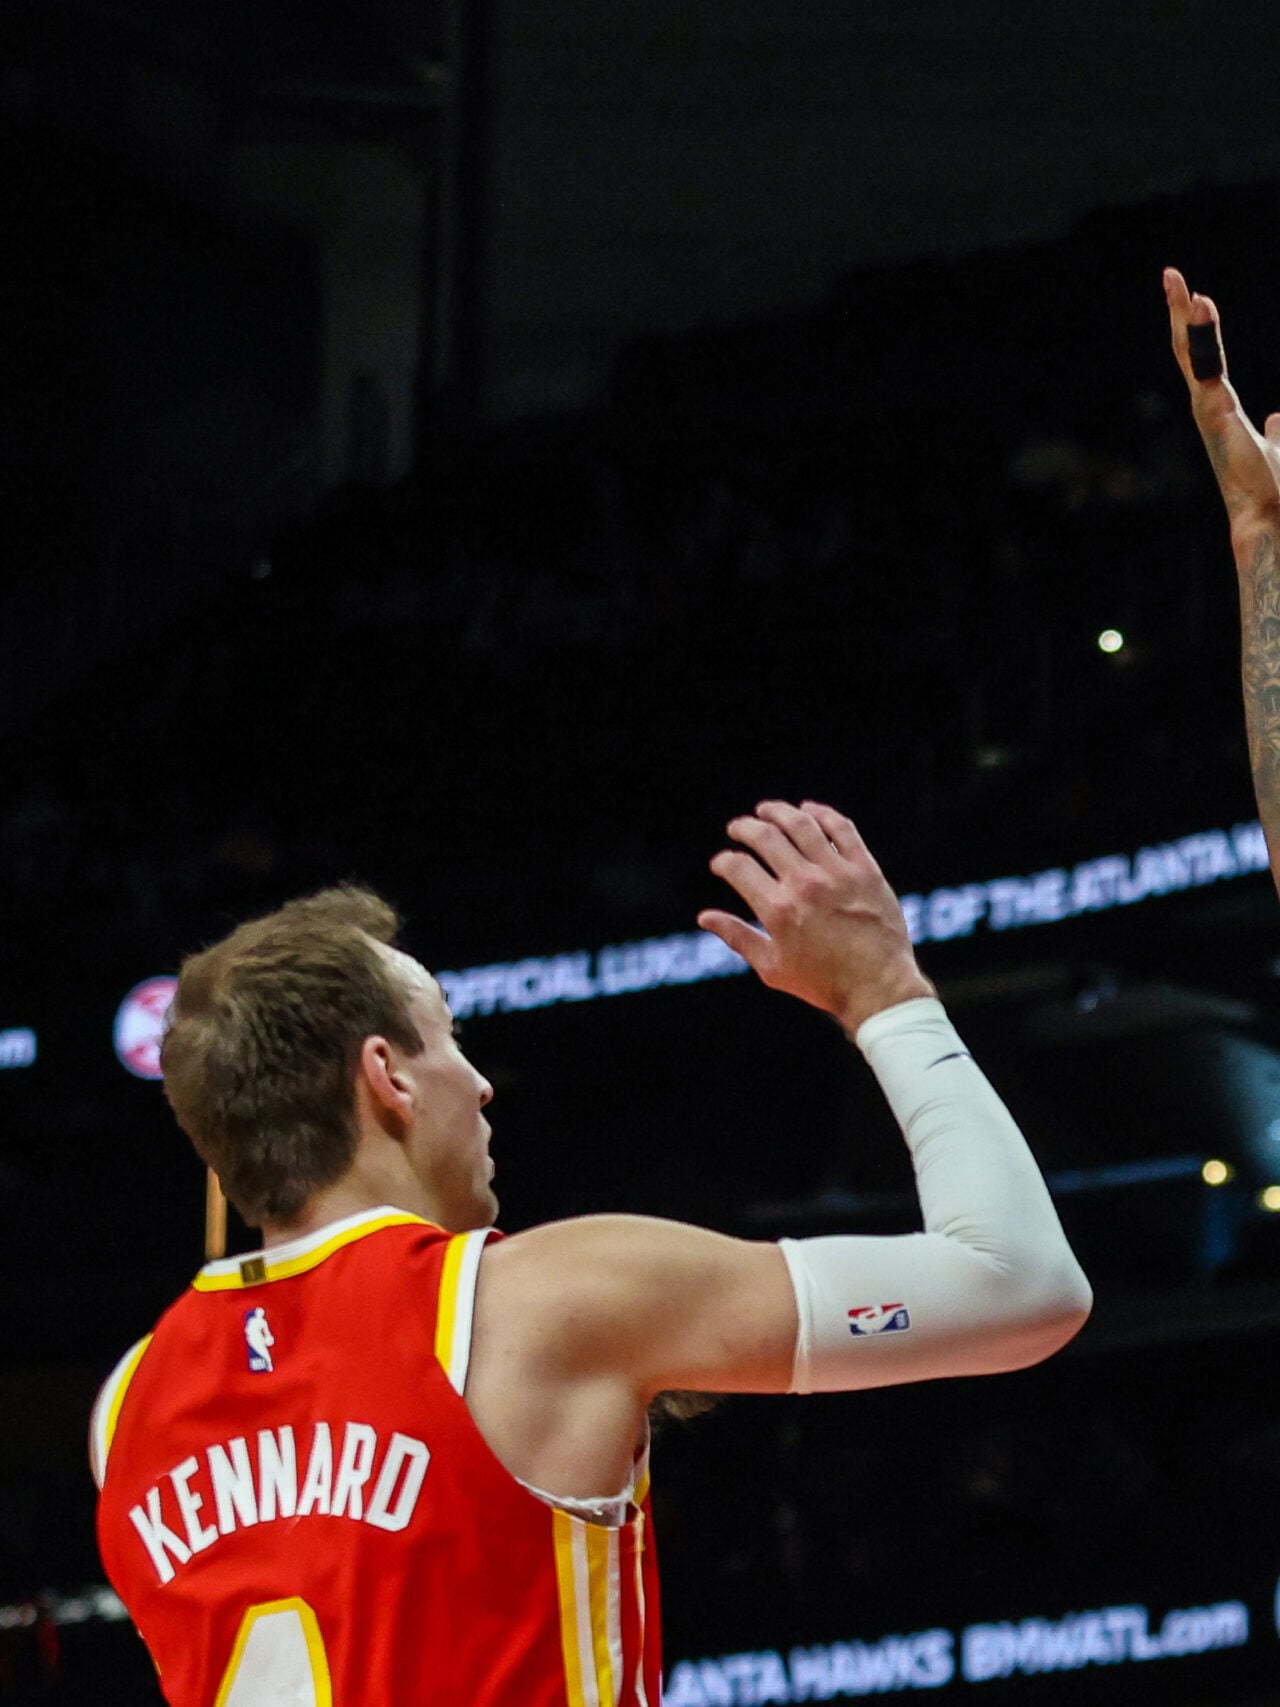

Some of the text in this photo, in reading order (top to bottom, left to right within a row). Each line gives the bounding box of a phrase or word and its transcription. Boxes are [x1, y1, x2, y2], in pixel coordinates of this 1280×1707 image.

[929, 884, 987, 943] OF
[986, 867, 1070, 931] THE
[1069, 829, 1236, 912] ATLANTA
[601, 926, 758, 996] LUXUR
[128, 1422, 430, 1586] KENNARD
[660, 1599, 1250, 1707] ANTA HAWKS BMWATL.com
